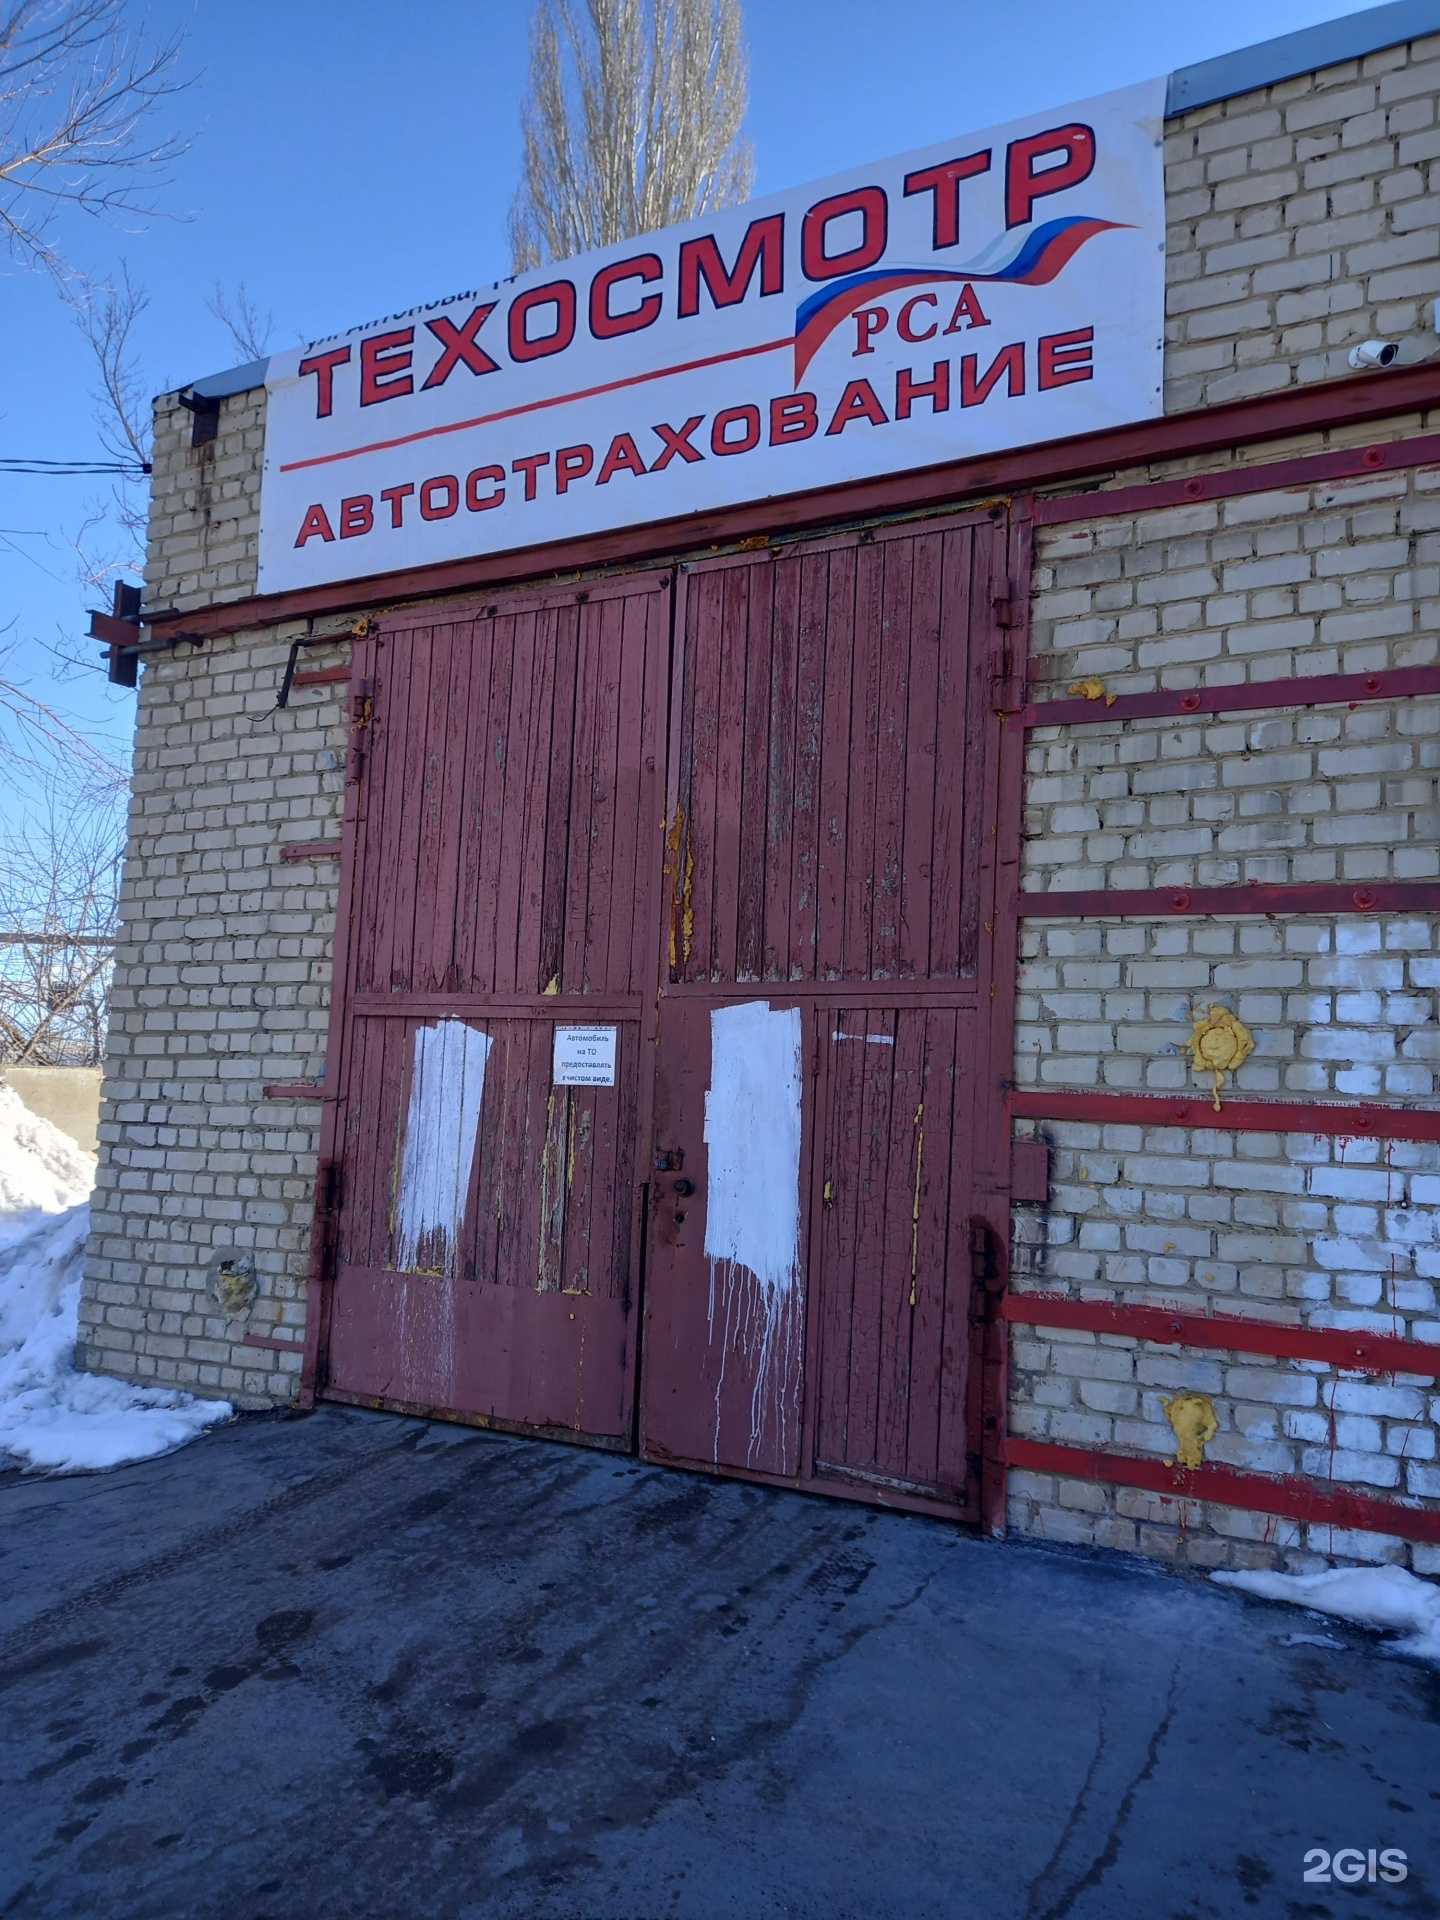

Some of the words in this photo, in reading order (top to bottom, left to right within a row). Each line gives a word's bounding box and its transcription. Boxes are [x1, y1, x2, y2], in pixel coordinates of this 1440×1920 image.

[298, 122, 1096, 419] ТЕХОСМОТР
[851, 281, 992, 357] РСА
[293, 325, 1095, 548] АВТОСТРАХОВАНИЕ
[566, 1034, 609, 1042] Автомобиль
[587, 1048, 597, 1056] ТО
[561, 1061, 612, 1069] предоставлять
